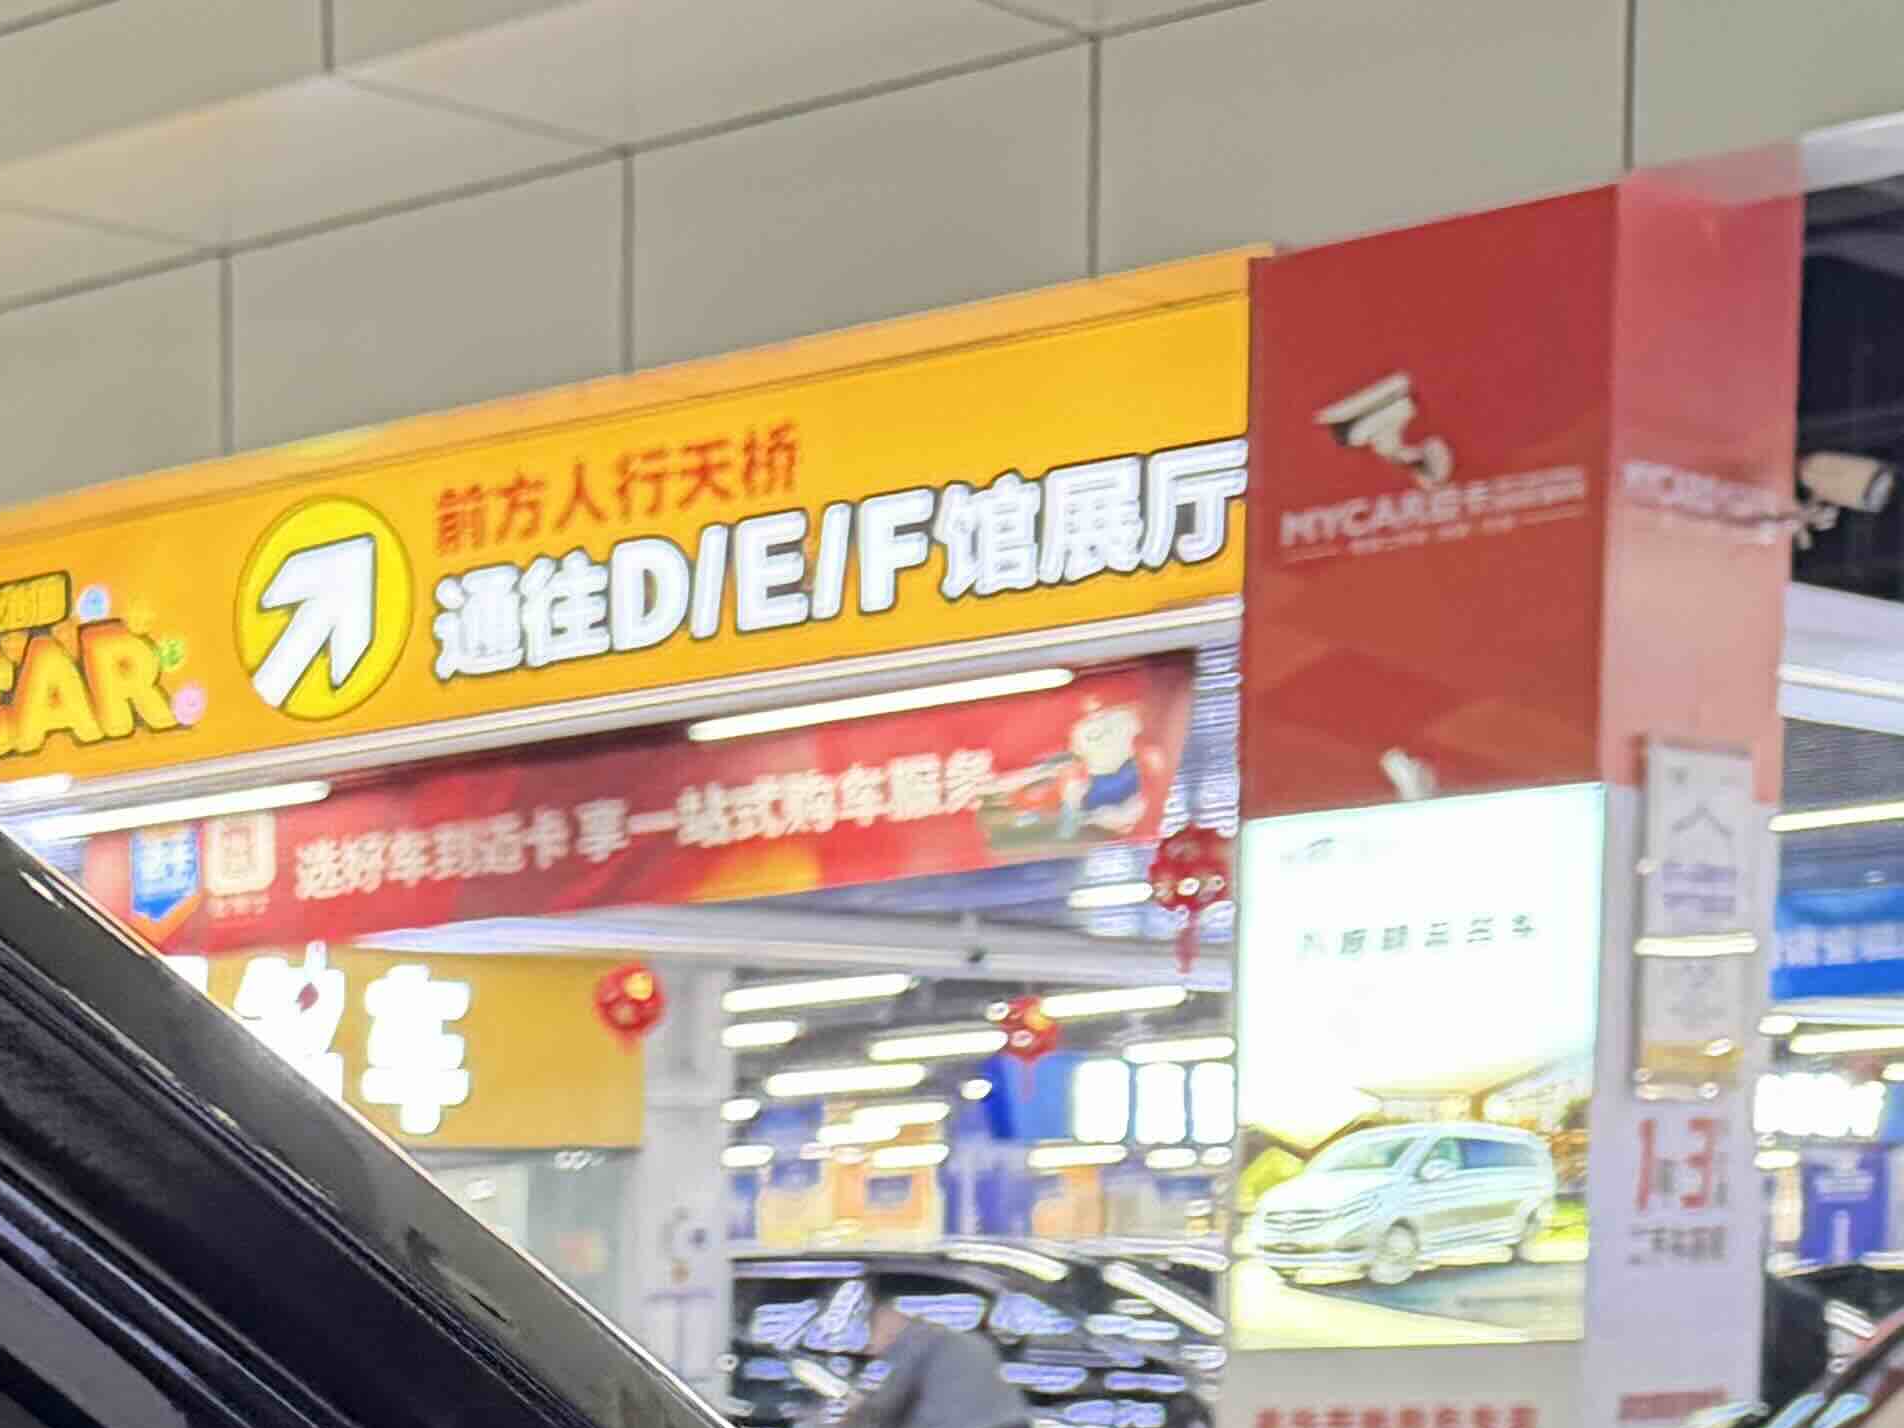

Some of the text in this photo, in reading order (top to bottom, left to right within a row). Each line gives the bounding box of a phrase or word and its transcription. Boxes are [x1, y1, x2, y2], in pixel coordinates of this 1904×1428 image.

[432, 438, 1248, 682] 通往D/E/F馆展厅
[435, 417, 800, 556] 前方人行天桥
